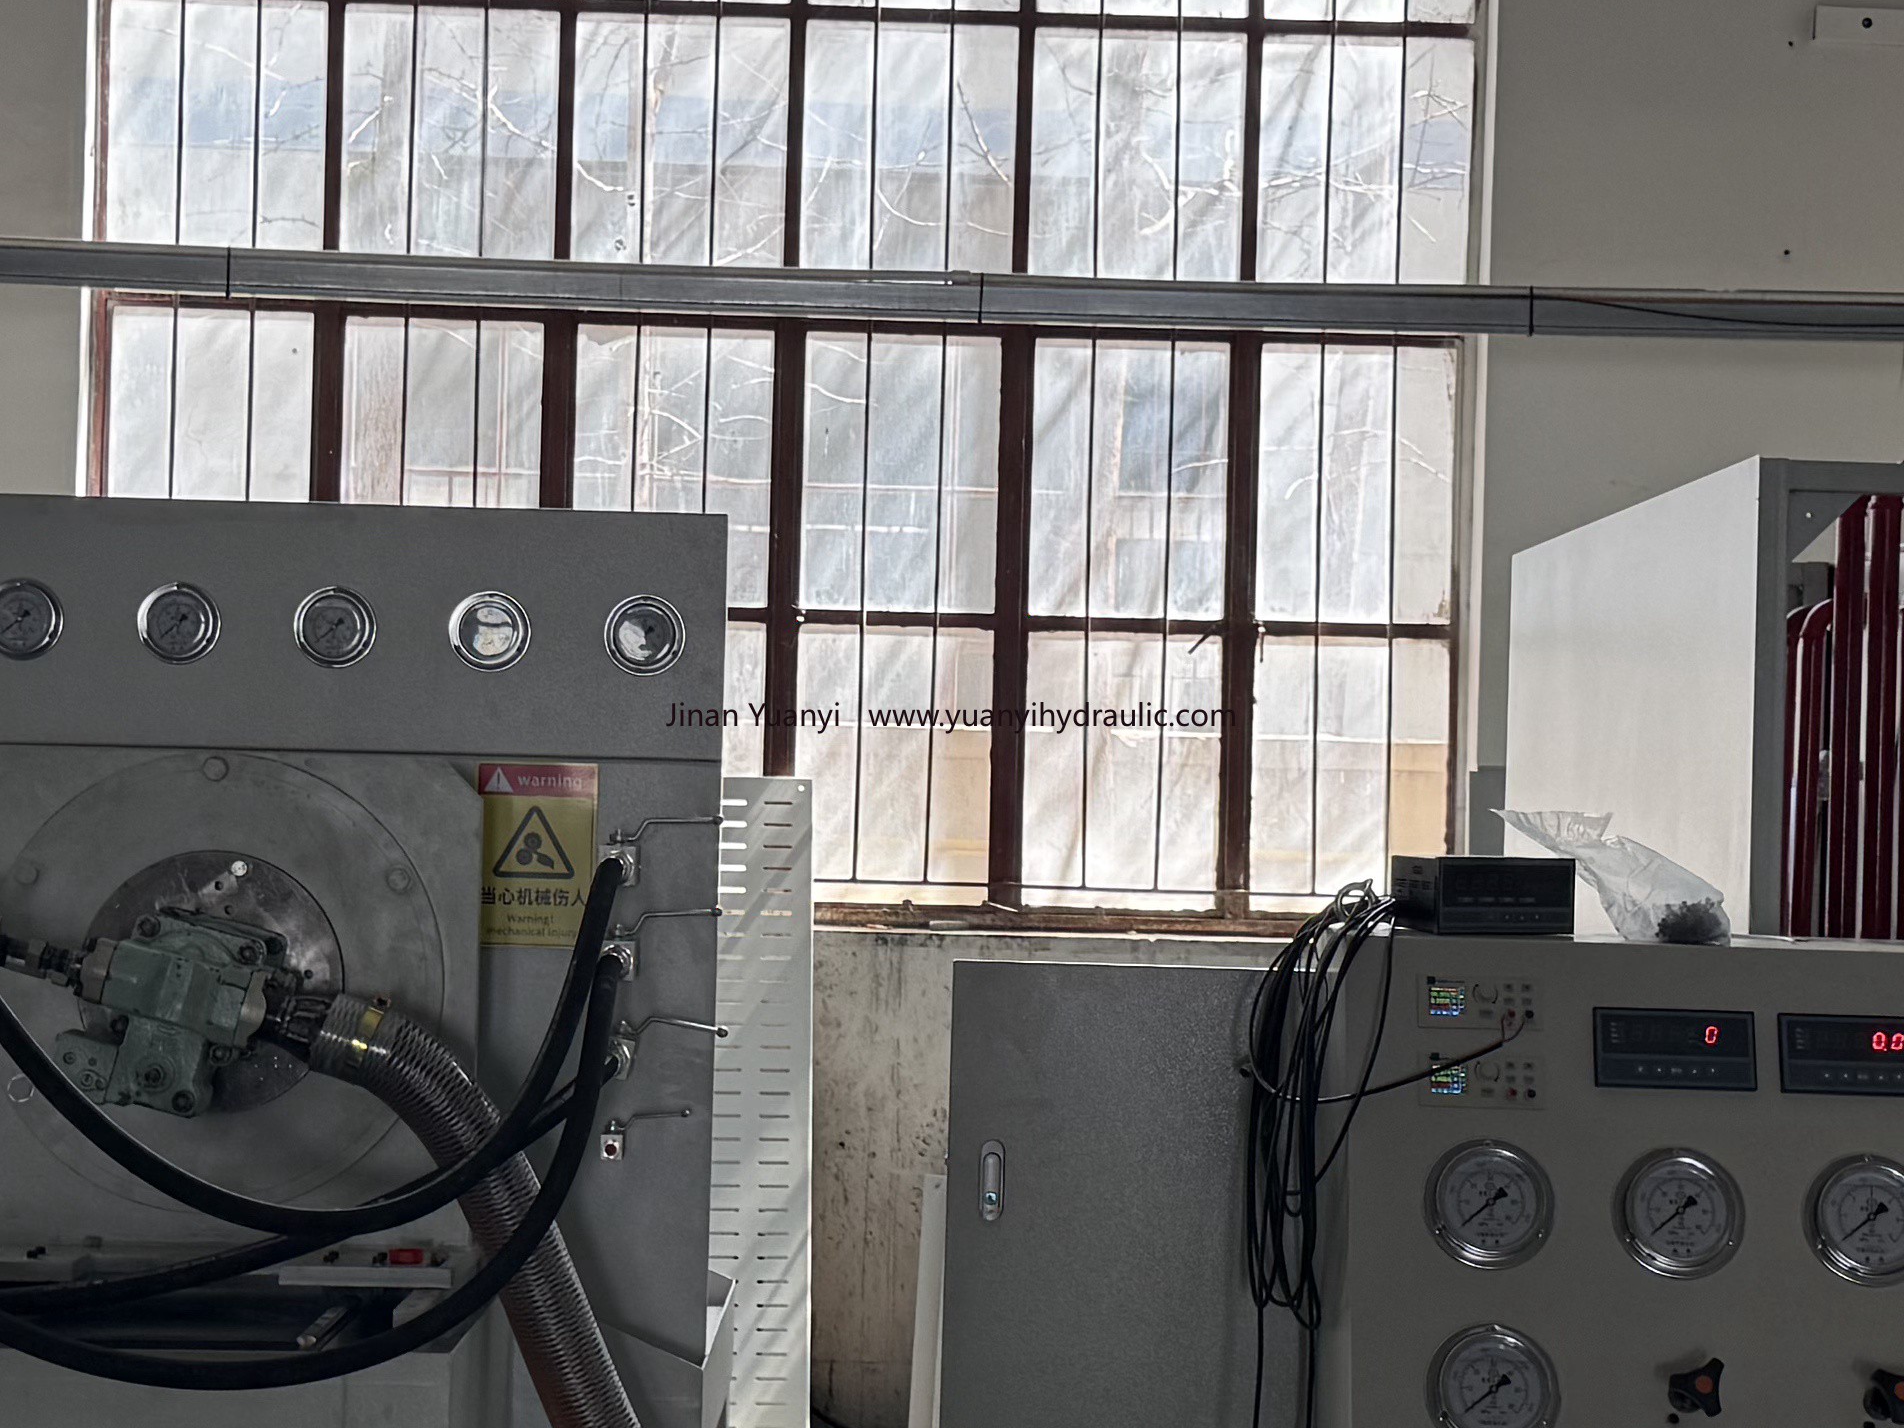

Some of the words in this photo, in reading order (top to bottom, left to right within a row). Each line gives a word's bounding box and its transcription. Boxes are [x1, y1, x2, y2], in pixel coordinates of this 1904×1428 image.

[517, 774, 583, 793] warning
[480, 886, 588, 908] 当心机械伤人
[1706, 1026, 1719, 1046] 0
